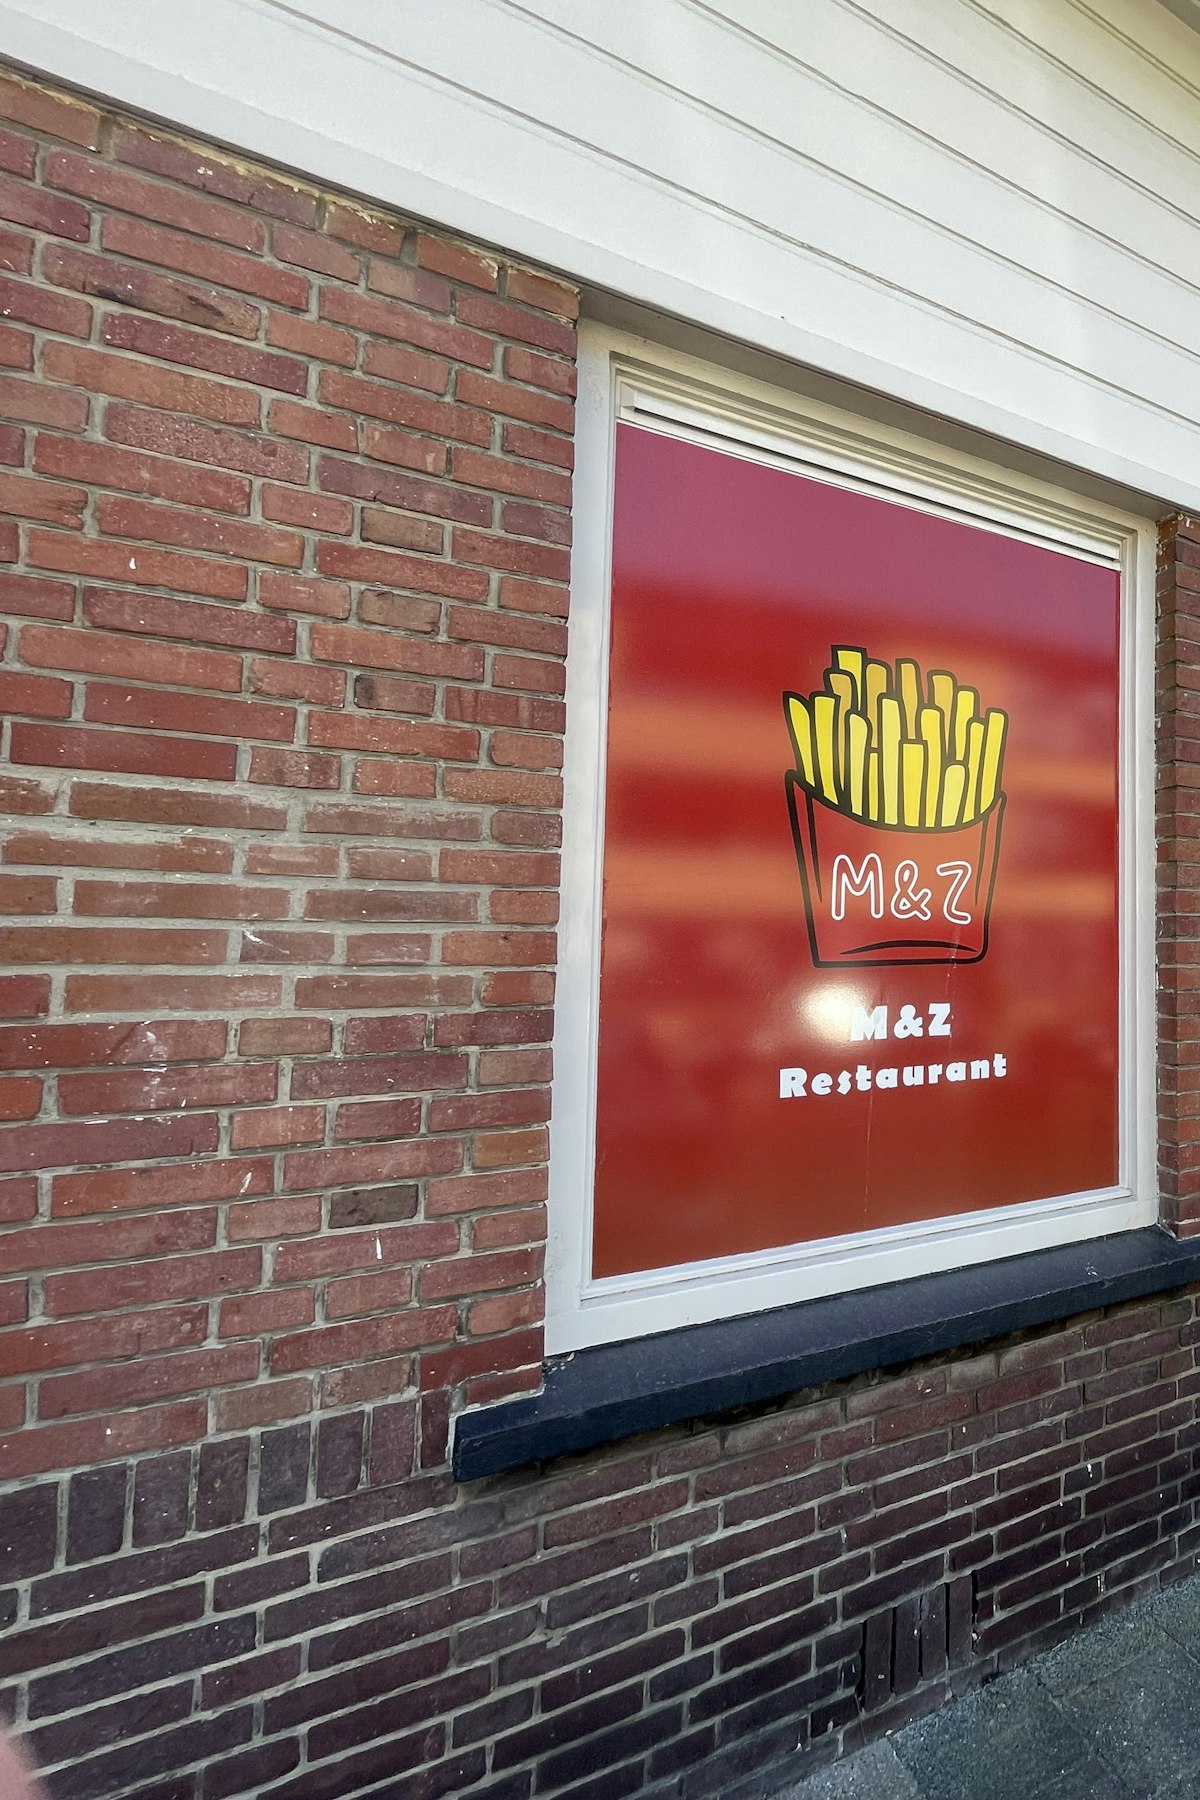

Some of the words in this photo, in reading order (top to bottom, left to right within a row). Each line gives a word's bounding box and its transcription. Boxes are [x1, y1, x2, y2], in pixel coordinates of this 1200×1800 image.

[831, 853, 972, 925] M&Z
[851, 1003, 951, 1042] M&Z
[779, 1053, 1007, 1099] Restaurant
